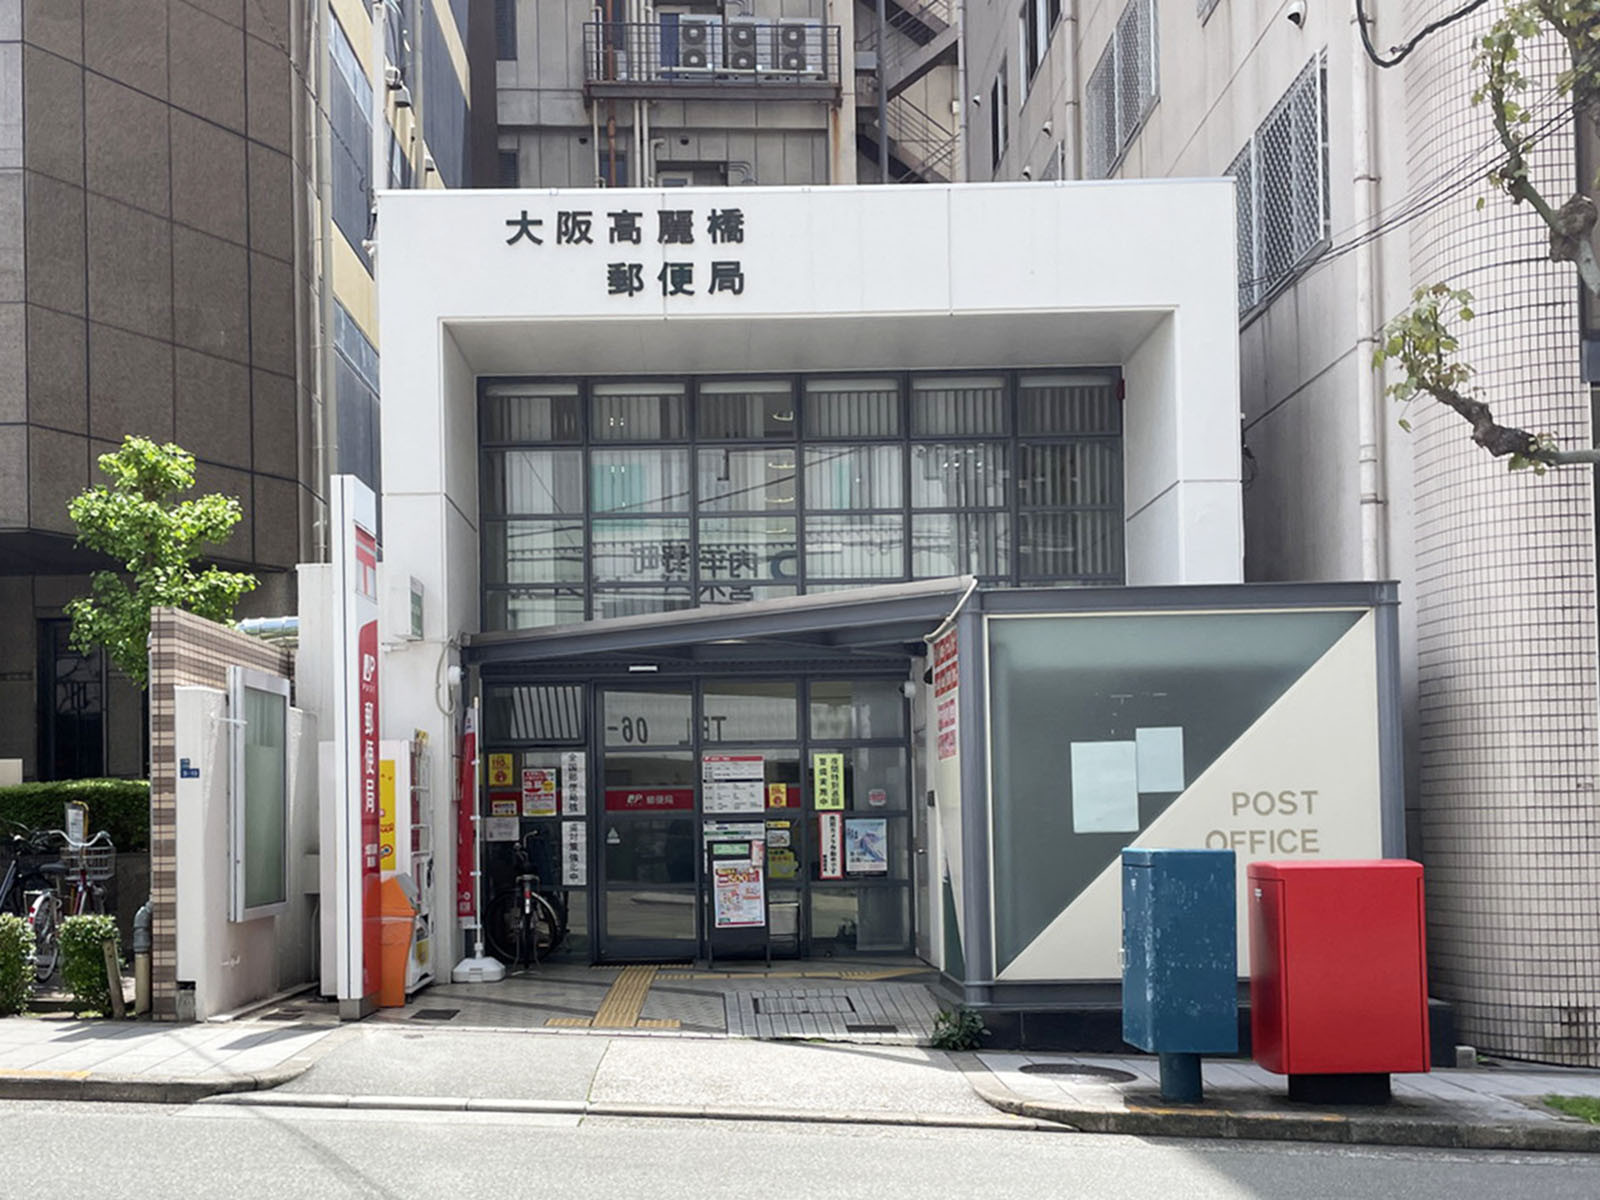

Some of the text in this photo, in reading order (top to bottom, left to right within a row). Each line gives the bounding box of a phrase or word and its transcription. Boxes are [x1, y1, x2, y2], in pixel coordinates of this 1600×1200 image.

[505, 208, 745, 246] 大阪高麗橋
[607, 260, 745, 297] 郵便局
[1232, 790, 1319, 816] POST
[1205, 829, 1320, 855] OFFICE
